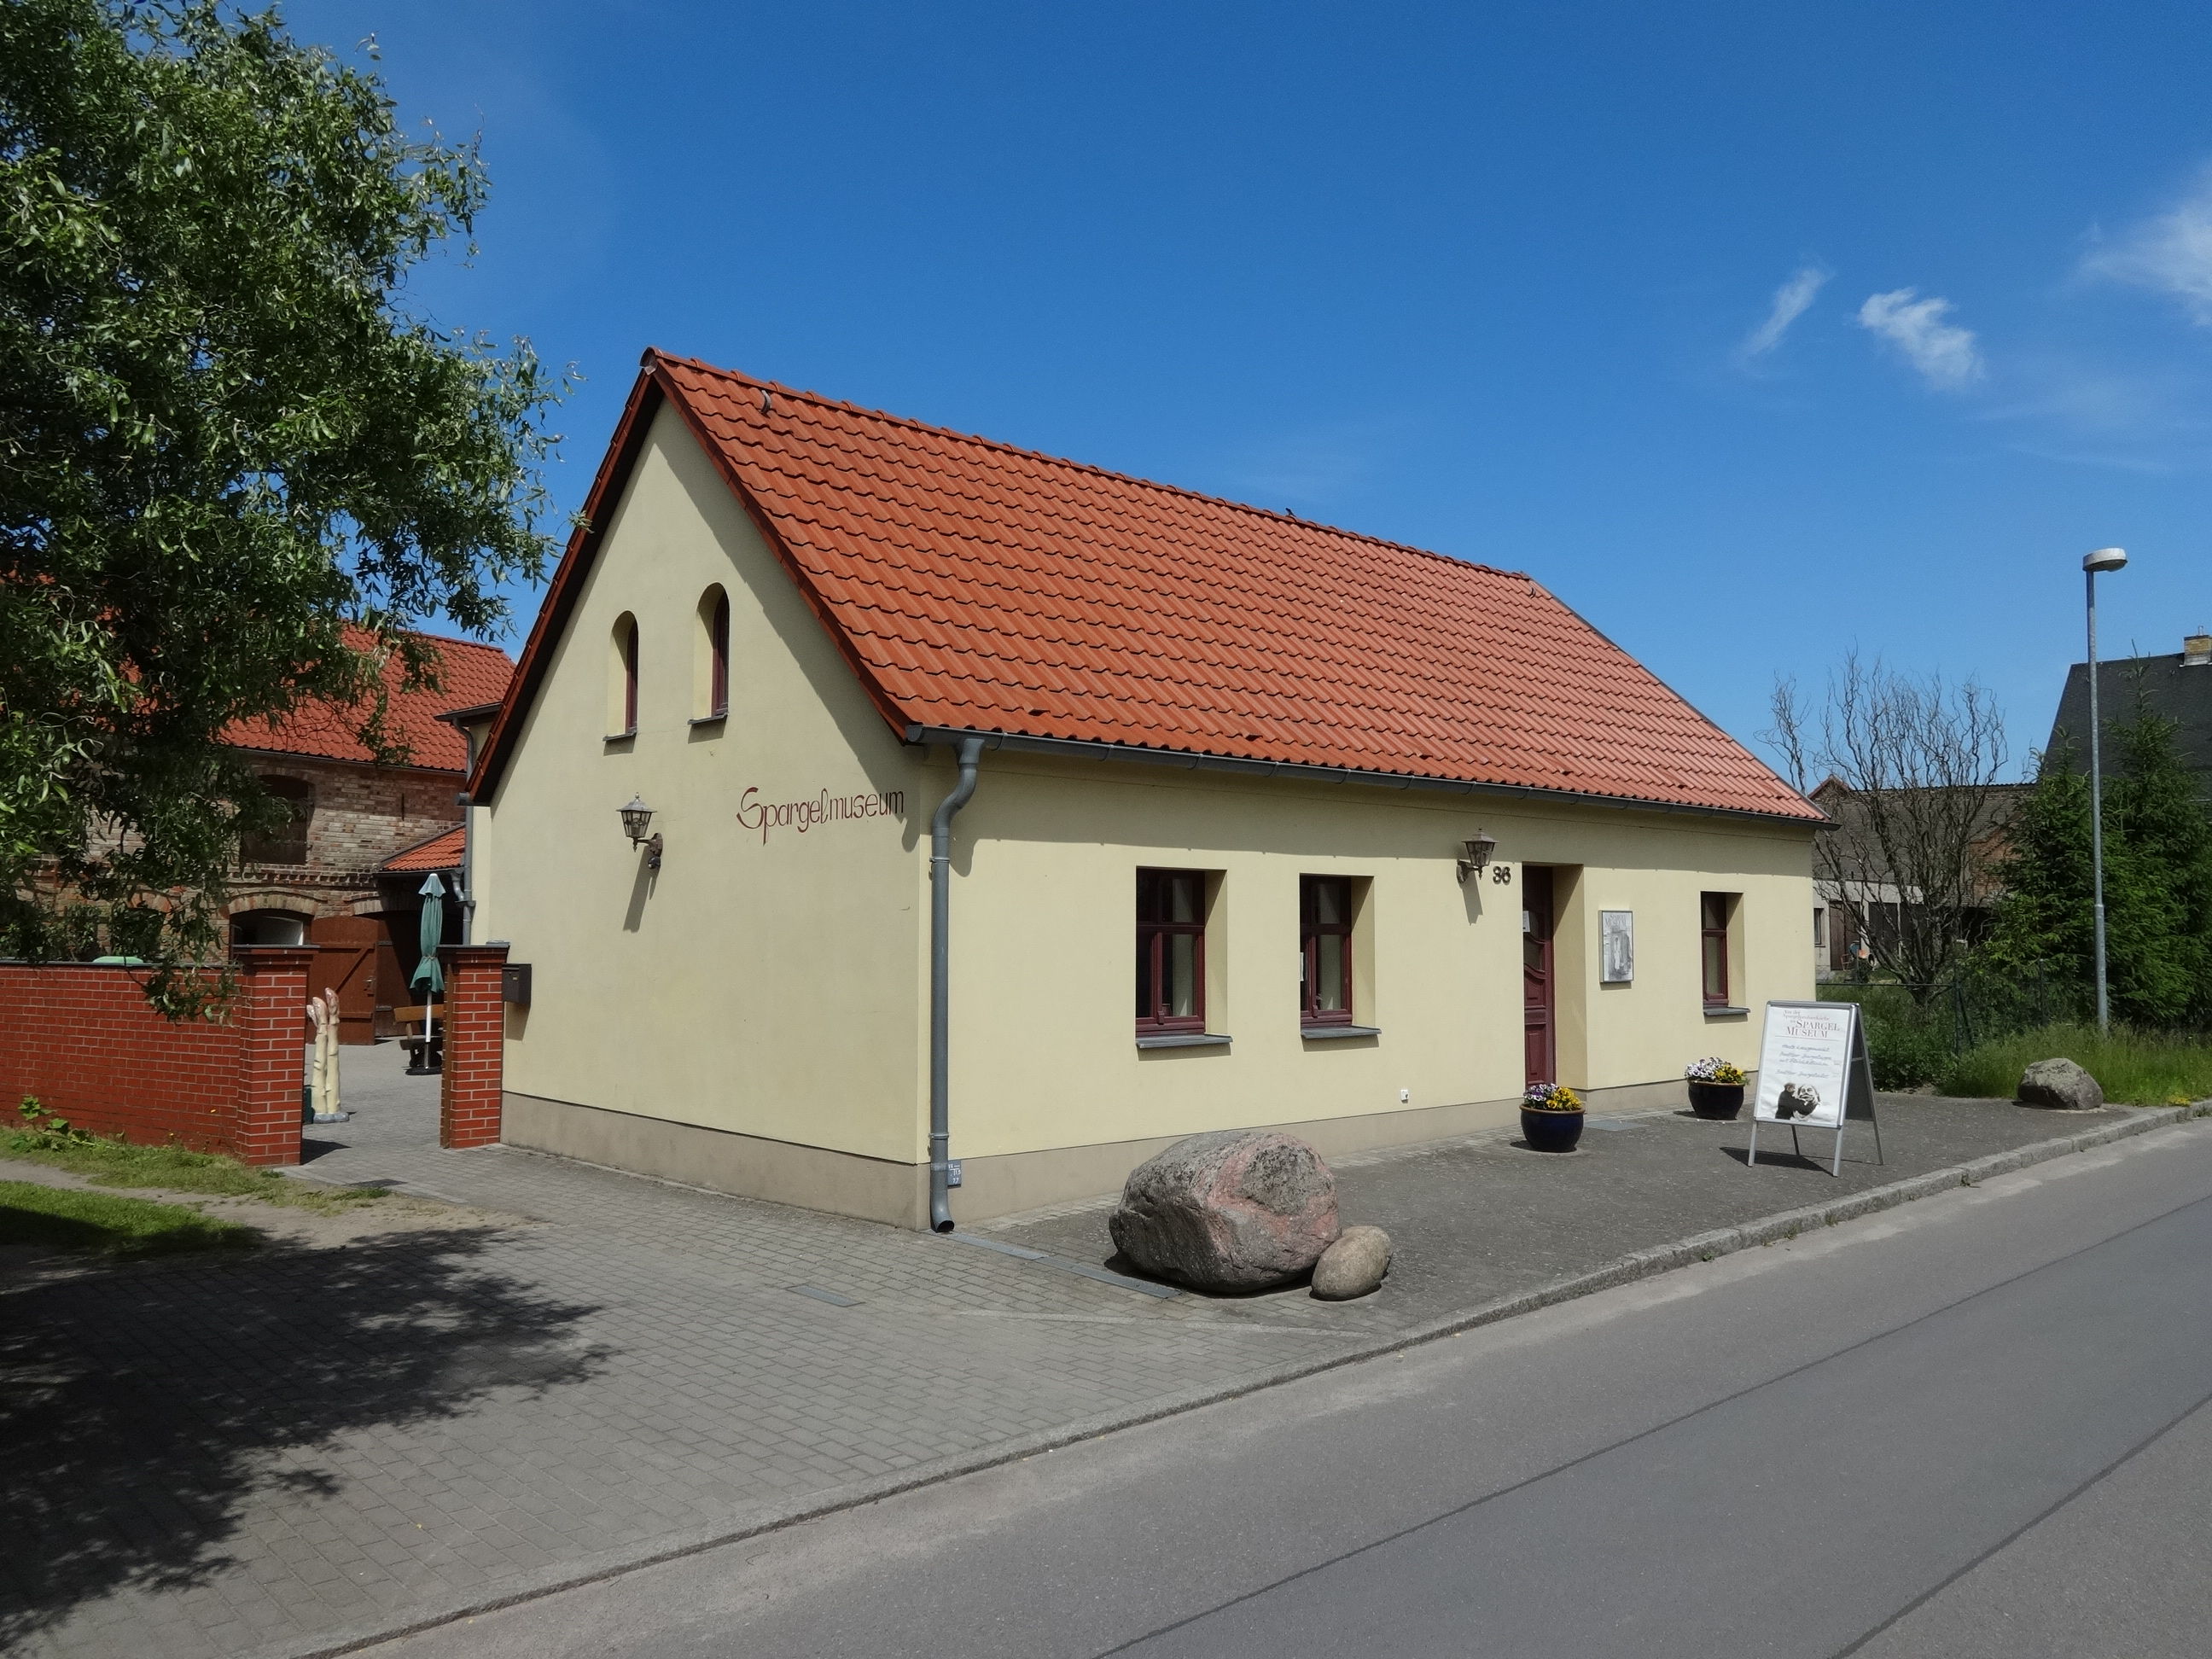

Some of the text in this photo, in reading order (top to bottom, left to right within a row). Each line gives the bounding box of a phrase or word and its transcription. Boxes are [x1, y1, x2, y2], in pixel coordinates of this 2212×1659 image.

[736, 787, 904, 847] Spargelmuseum
[1493, 865, 1511, 886] 36
[1787, 1027, 1828, 1039] MUSEUM
[1796, 1020, 1840, 1032] SPARGEL
